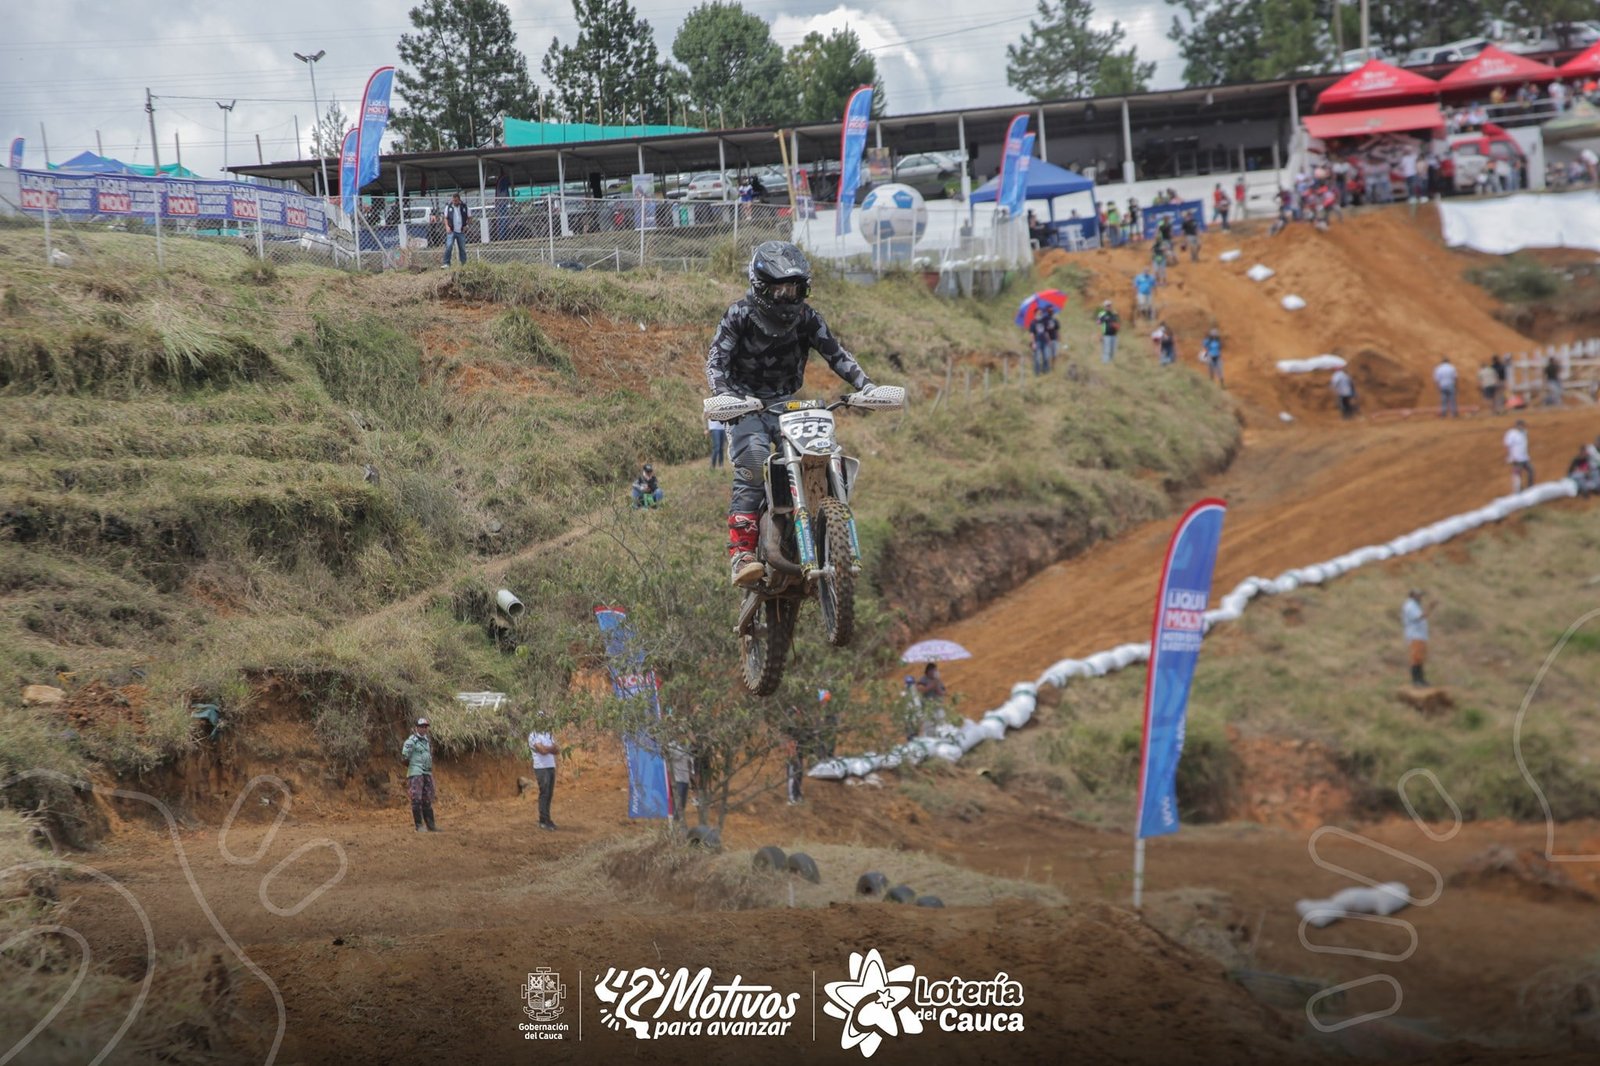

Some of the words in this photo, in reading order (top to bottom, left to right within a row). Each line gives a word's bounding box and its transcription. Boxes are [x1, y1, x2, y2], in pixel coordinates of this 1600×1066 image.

[100, 195, 130, 211] MOLY
[168, 198, 197, 214] MOLY
[287, 209, 307, 227] MOLY
[790, 421, 833, 440] 333
[1168, 590, 1207, 610] LIQUI
